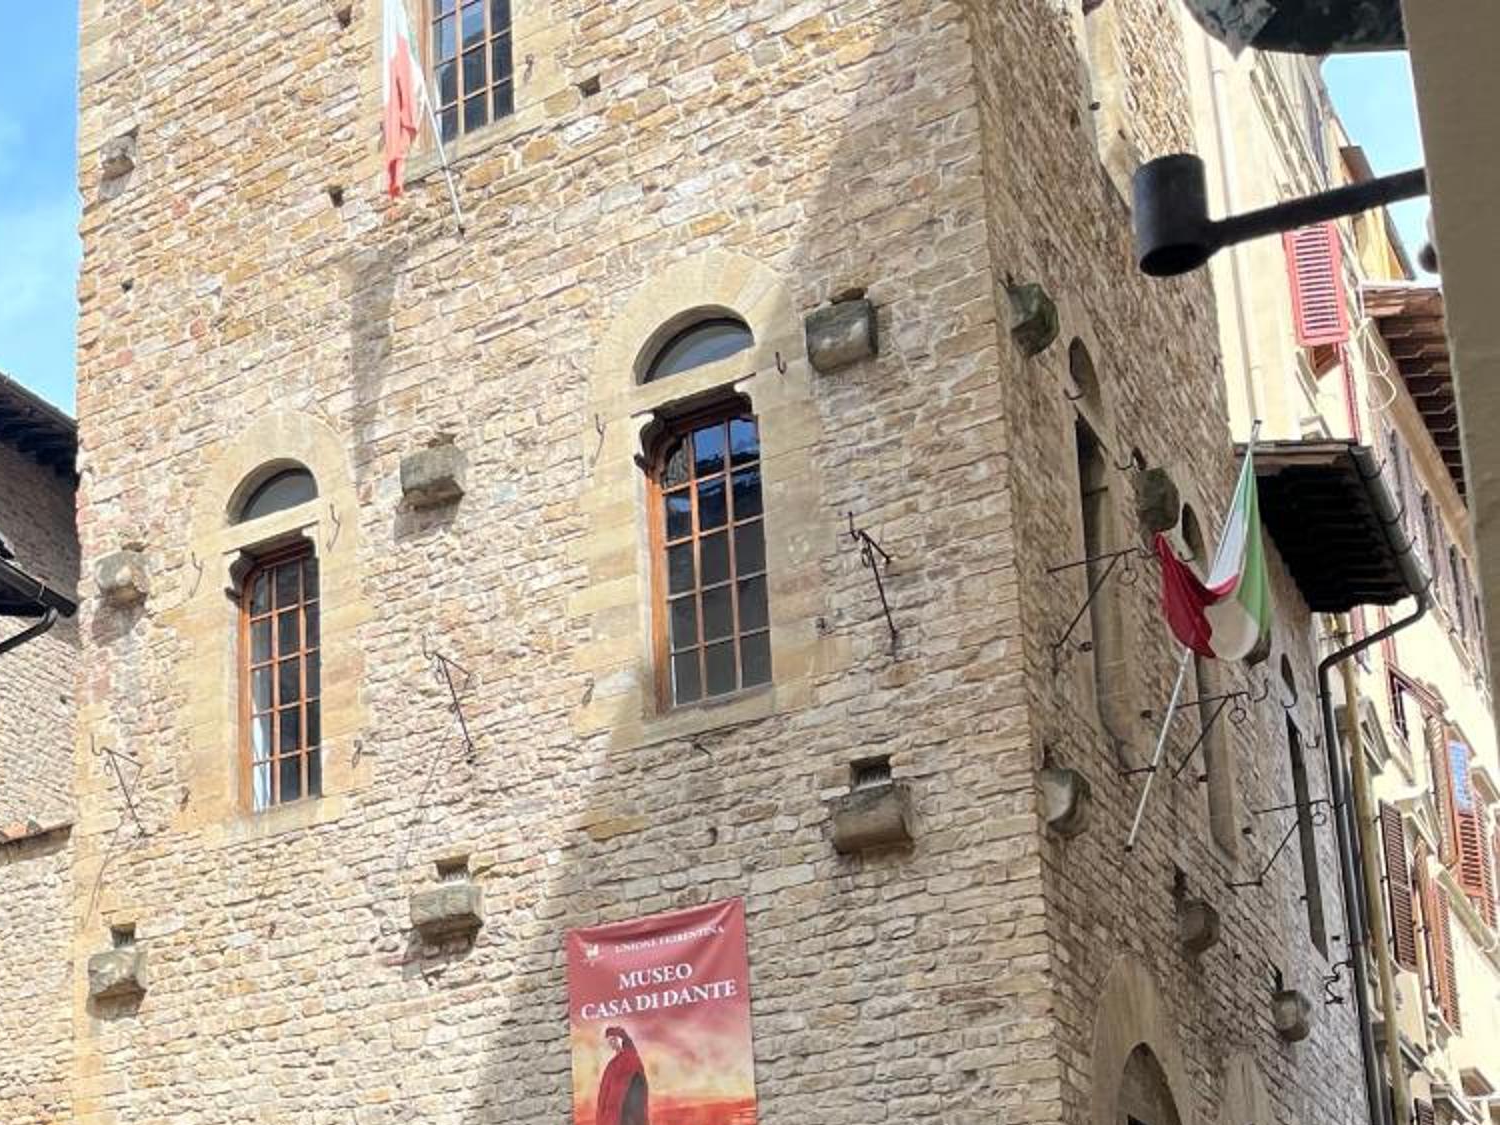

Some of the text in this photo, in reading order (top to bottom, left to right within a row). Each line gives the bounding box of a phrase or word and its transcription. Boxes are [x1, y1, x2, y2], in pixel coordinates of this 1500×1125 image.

[619, 962, 693, 990] MUSEO
[581, 979, 737, 1021] CASA DI DANTE
